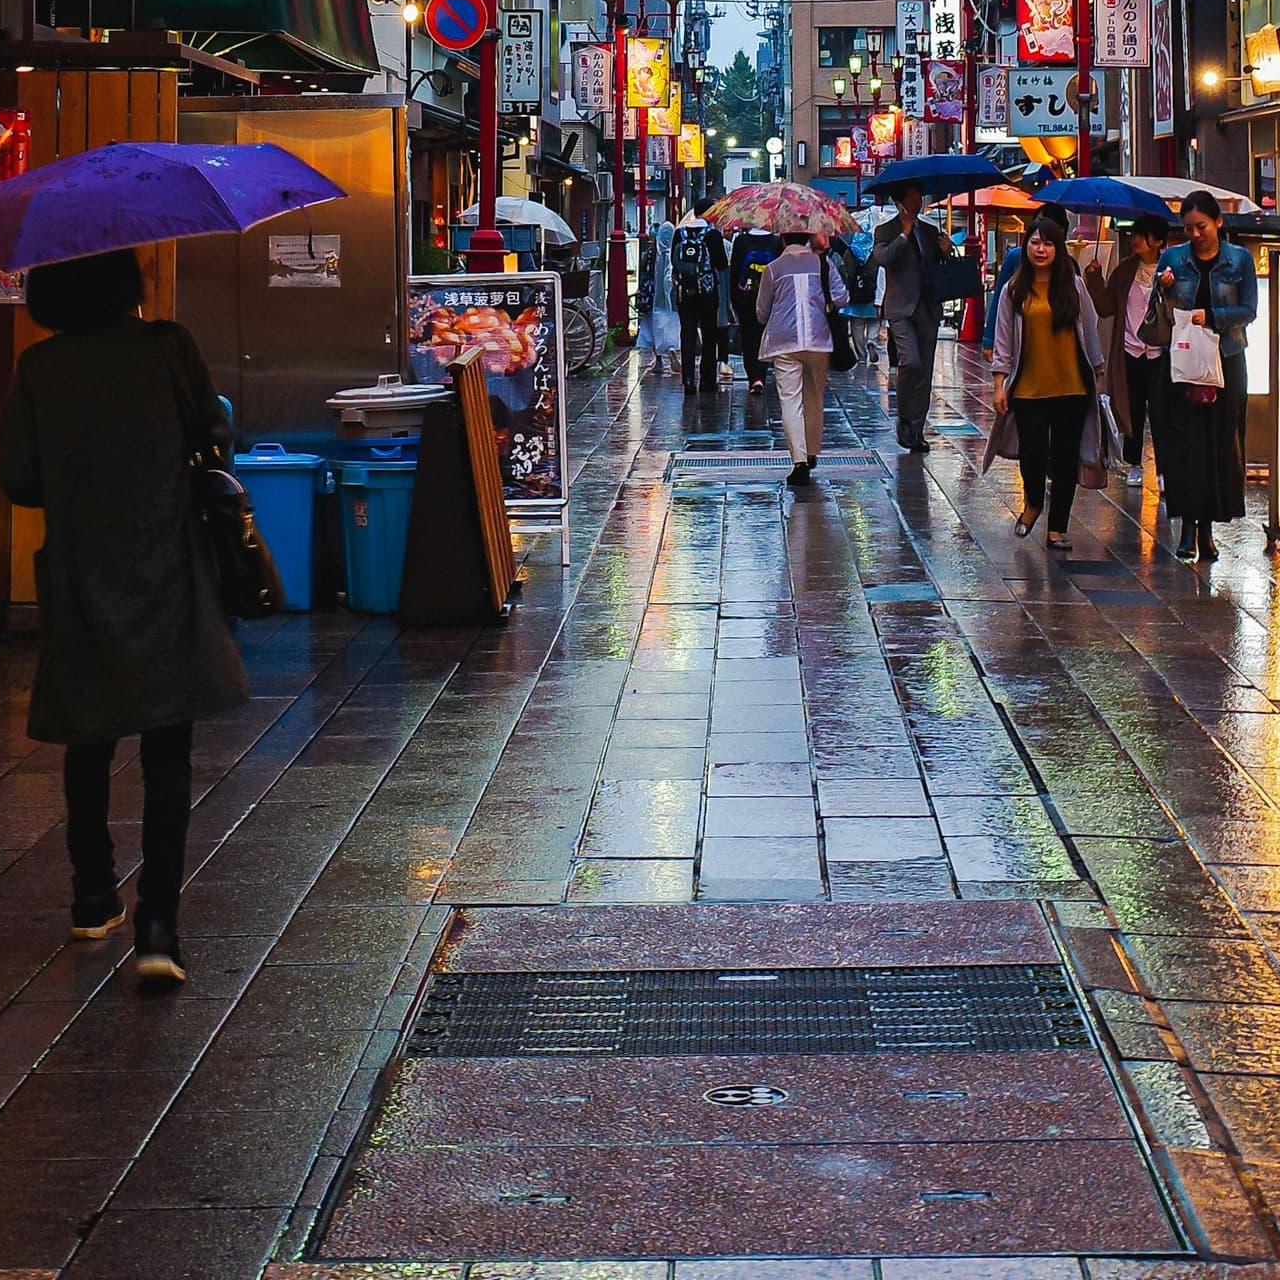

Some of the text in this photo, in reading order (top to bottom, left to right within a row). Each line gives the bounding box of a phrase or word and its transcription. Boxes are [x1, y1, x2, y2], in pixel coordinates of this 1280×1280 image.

[1107, 11, 1117, 56] メトロ商店会
[593, 53, 605, 105] かんのん通り
[503, 103, 538, 112] B1F
[444, 291, 521, 306] 浅草菠萝包
